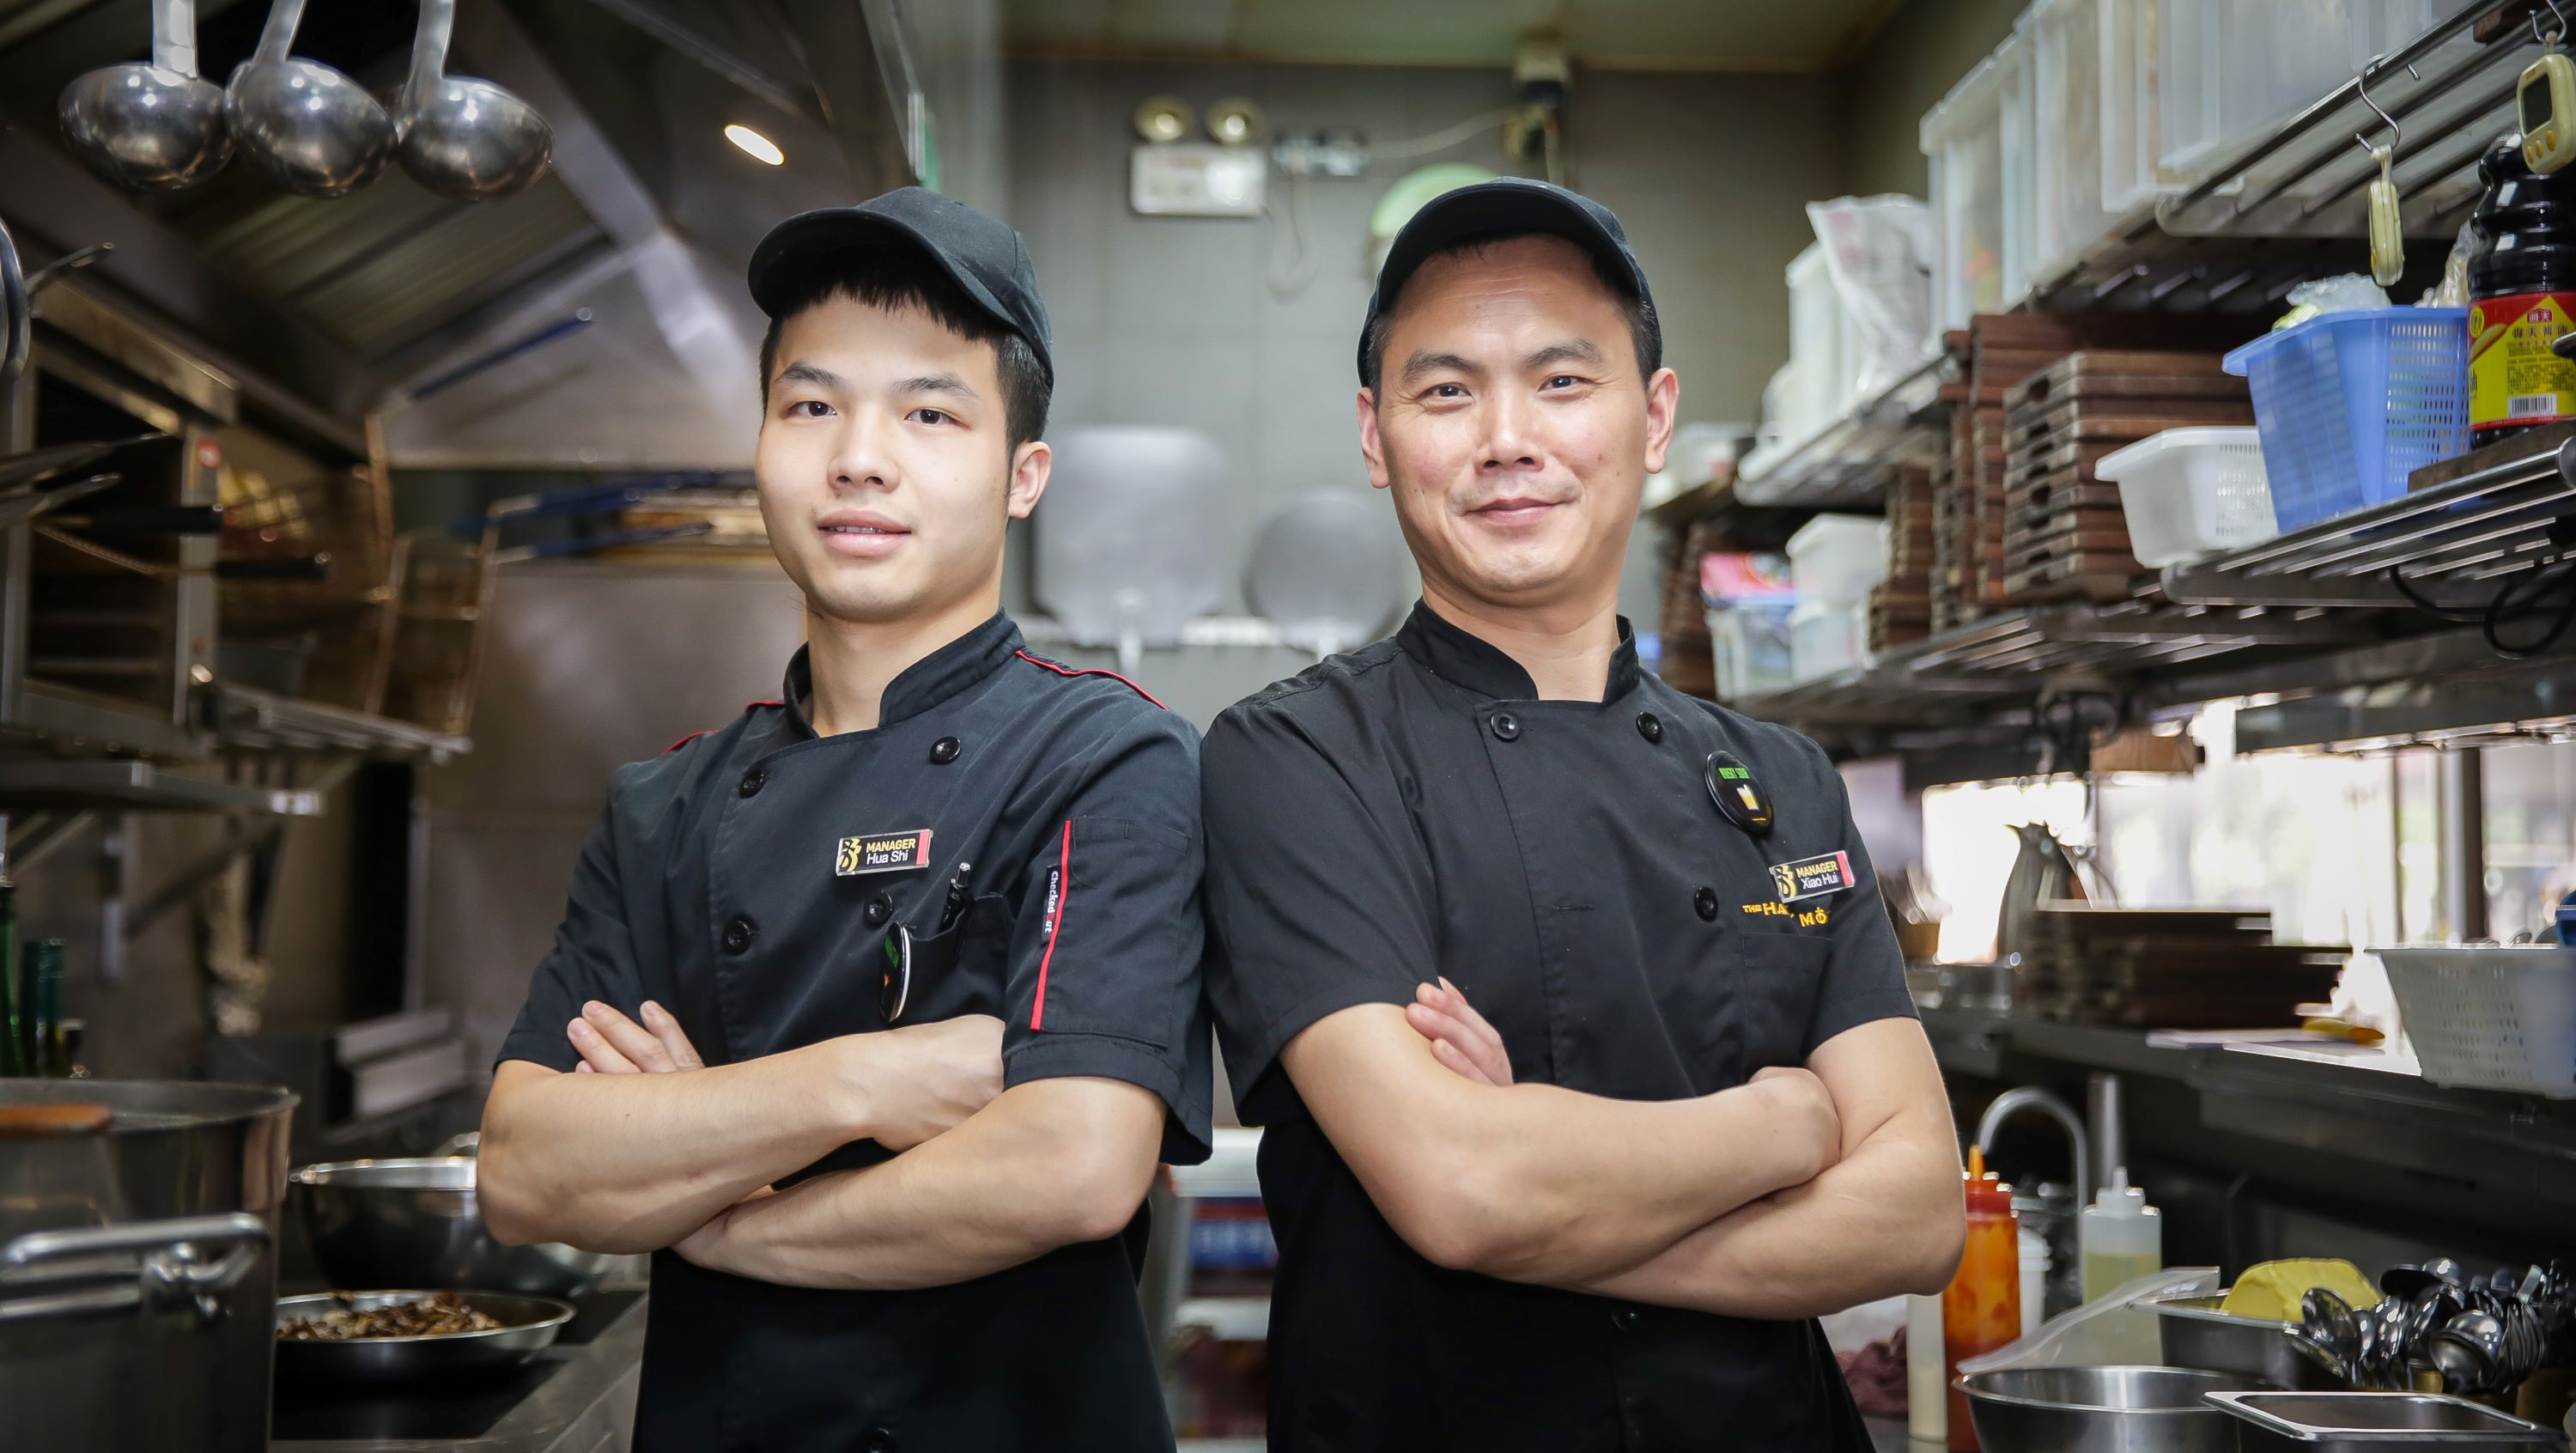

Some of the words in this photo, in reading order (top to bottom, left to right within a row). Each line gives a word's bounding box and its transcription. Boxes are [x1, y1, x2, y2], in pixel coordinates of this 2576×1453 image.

[866, 838, 916, 853] MANAGER
[866, 852, 889, 865] Hua
[890, 849, 908, 862] Shi
[1795, 860, 1838, 878] MANAGER
[1801, 876, 1822, 890] Xiao
[1821, 872, 1838, 885] Hui
[1742, 904, 1763, 913] THE
